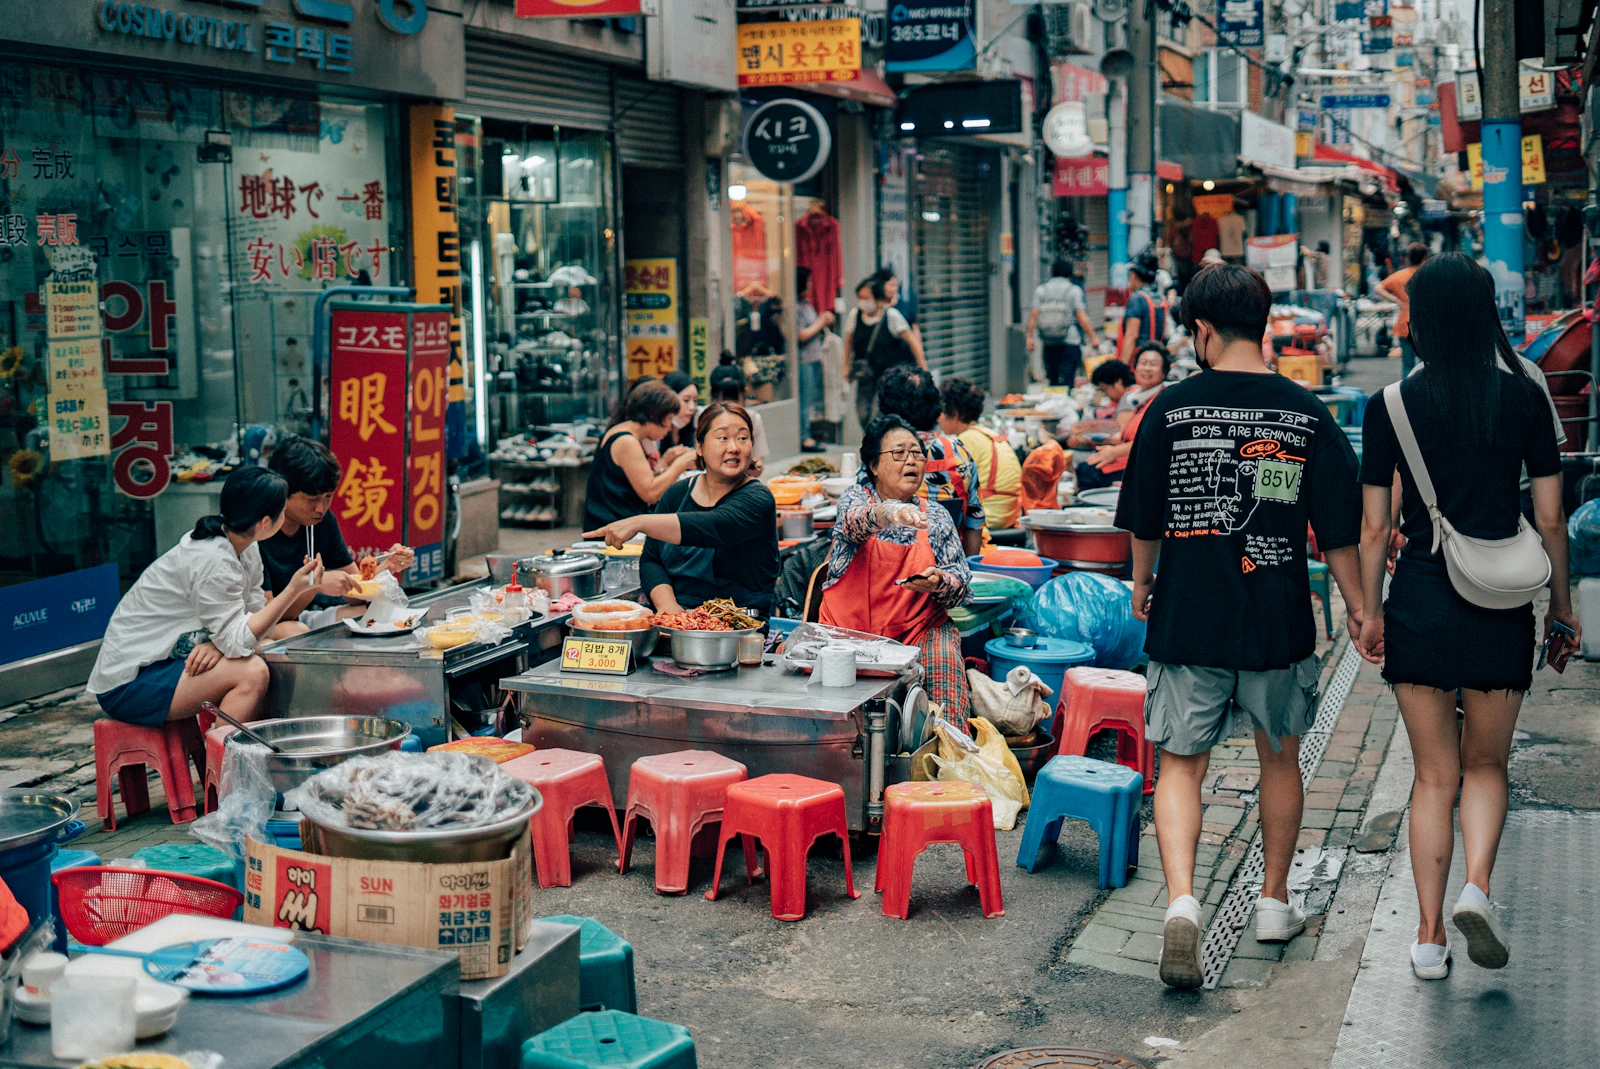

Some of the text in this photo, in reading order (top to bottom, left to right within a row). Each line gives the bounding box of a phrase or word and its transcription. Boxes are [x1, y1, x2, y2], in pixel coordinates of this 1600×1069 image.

[101, 2, 354, 73] COSMO OPTICAL 콘택트
[891, 22, 959, 42] 365코너
[742, 39, 854, 69] 맵시 옷수선
[755, 116, 811, 143] 시크
[32, 147, 74, 180] 完成
[239, 174, 386, 221] 地球で 一番
[36, 211, 79, 246] 売販
[90, 235, 168, 258] 코스모
[246, 236, 388, 281] 安い店です
[339, 326, 405, 348] コスモ
[415, 321, 447, 346] 코스모
[630, 344, 674, 375] 수선
[102, 280, 177, 499] 안경
[1166, 410, 1191, 423] THE
[1194, 409, 1264, 420] FLAGSHIP
[1192, 425, 1307, 447] BOYS ARE REMINDED
[338, 372, 397, 533] 眼鏡
[414, 367, 445, 531] 안경
[1246, 443, 1276, 454] OMEGA
[1261, 469, 1297, 490] 85V
[13, 607, 48, 627] ACUVUE
[567, 647, 578, 659] 12
[585, 643, 625, 656] 김밥 8개
[588, 658, 616, 668] 3.000
[287, 866, 316, 890] 하이
[360, 877, 393, 893] SUN
[439, 892, 492, 909] 화기엄금
[439, 909, 491, 926] 취급주의
